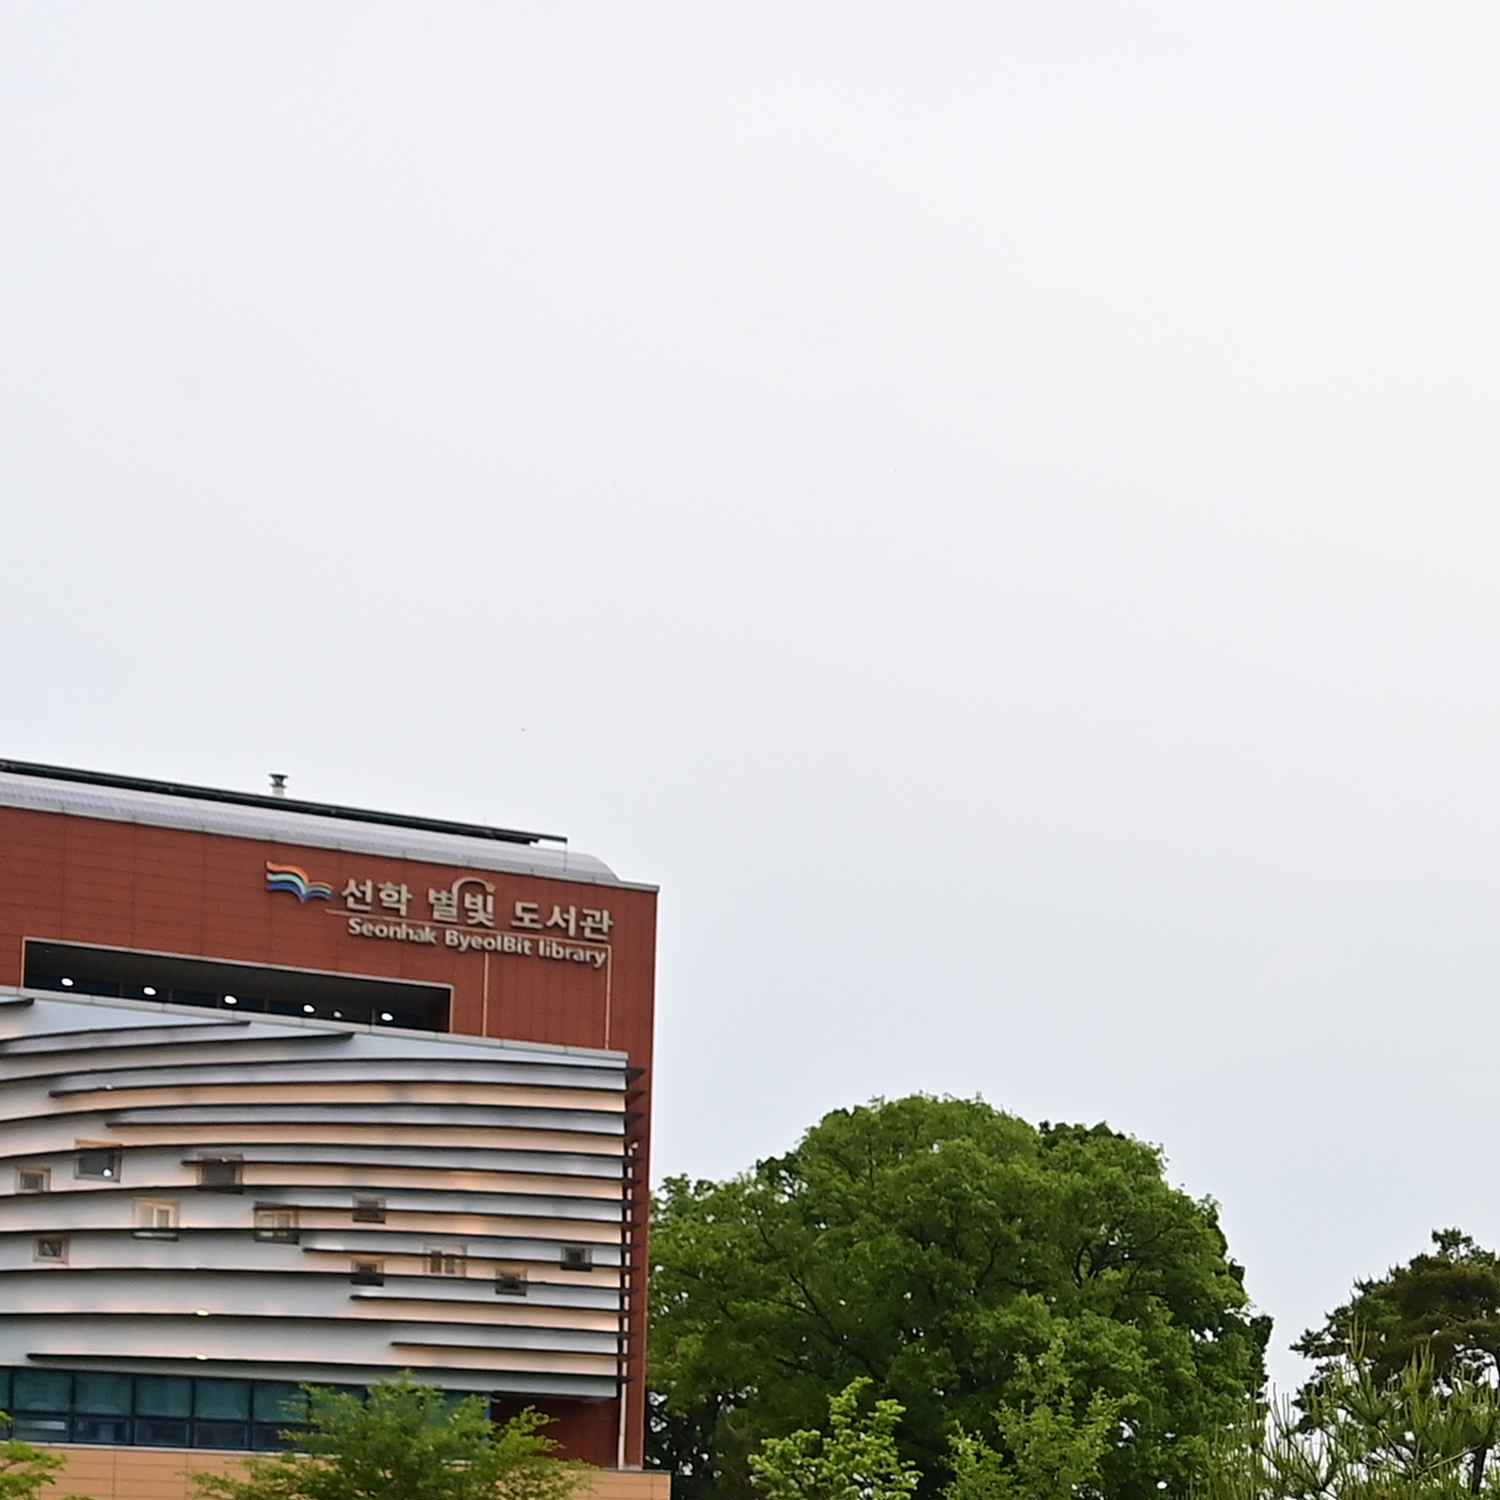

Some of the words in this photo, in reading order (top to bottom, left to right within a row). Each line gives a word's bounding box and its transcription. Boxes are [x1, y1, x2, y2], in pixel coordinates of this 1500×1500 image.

[341, 878, 412, 917] 선학
[428, 882, 496, 928] 별빛
[511, 901, 614, 942] 도서관
[348, 917, 437, 945] Seonhak
[445, 930, 532, 956] ByeolBit
[538, 939, 606, 968] library
